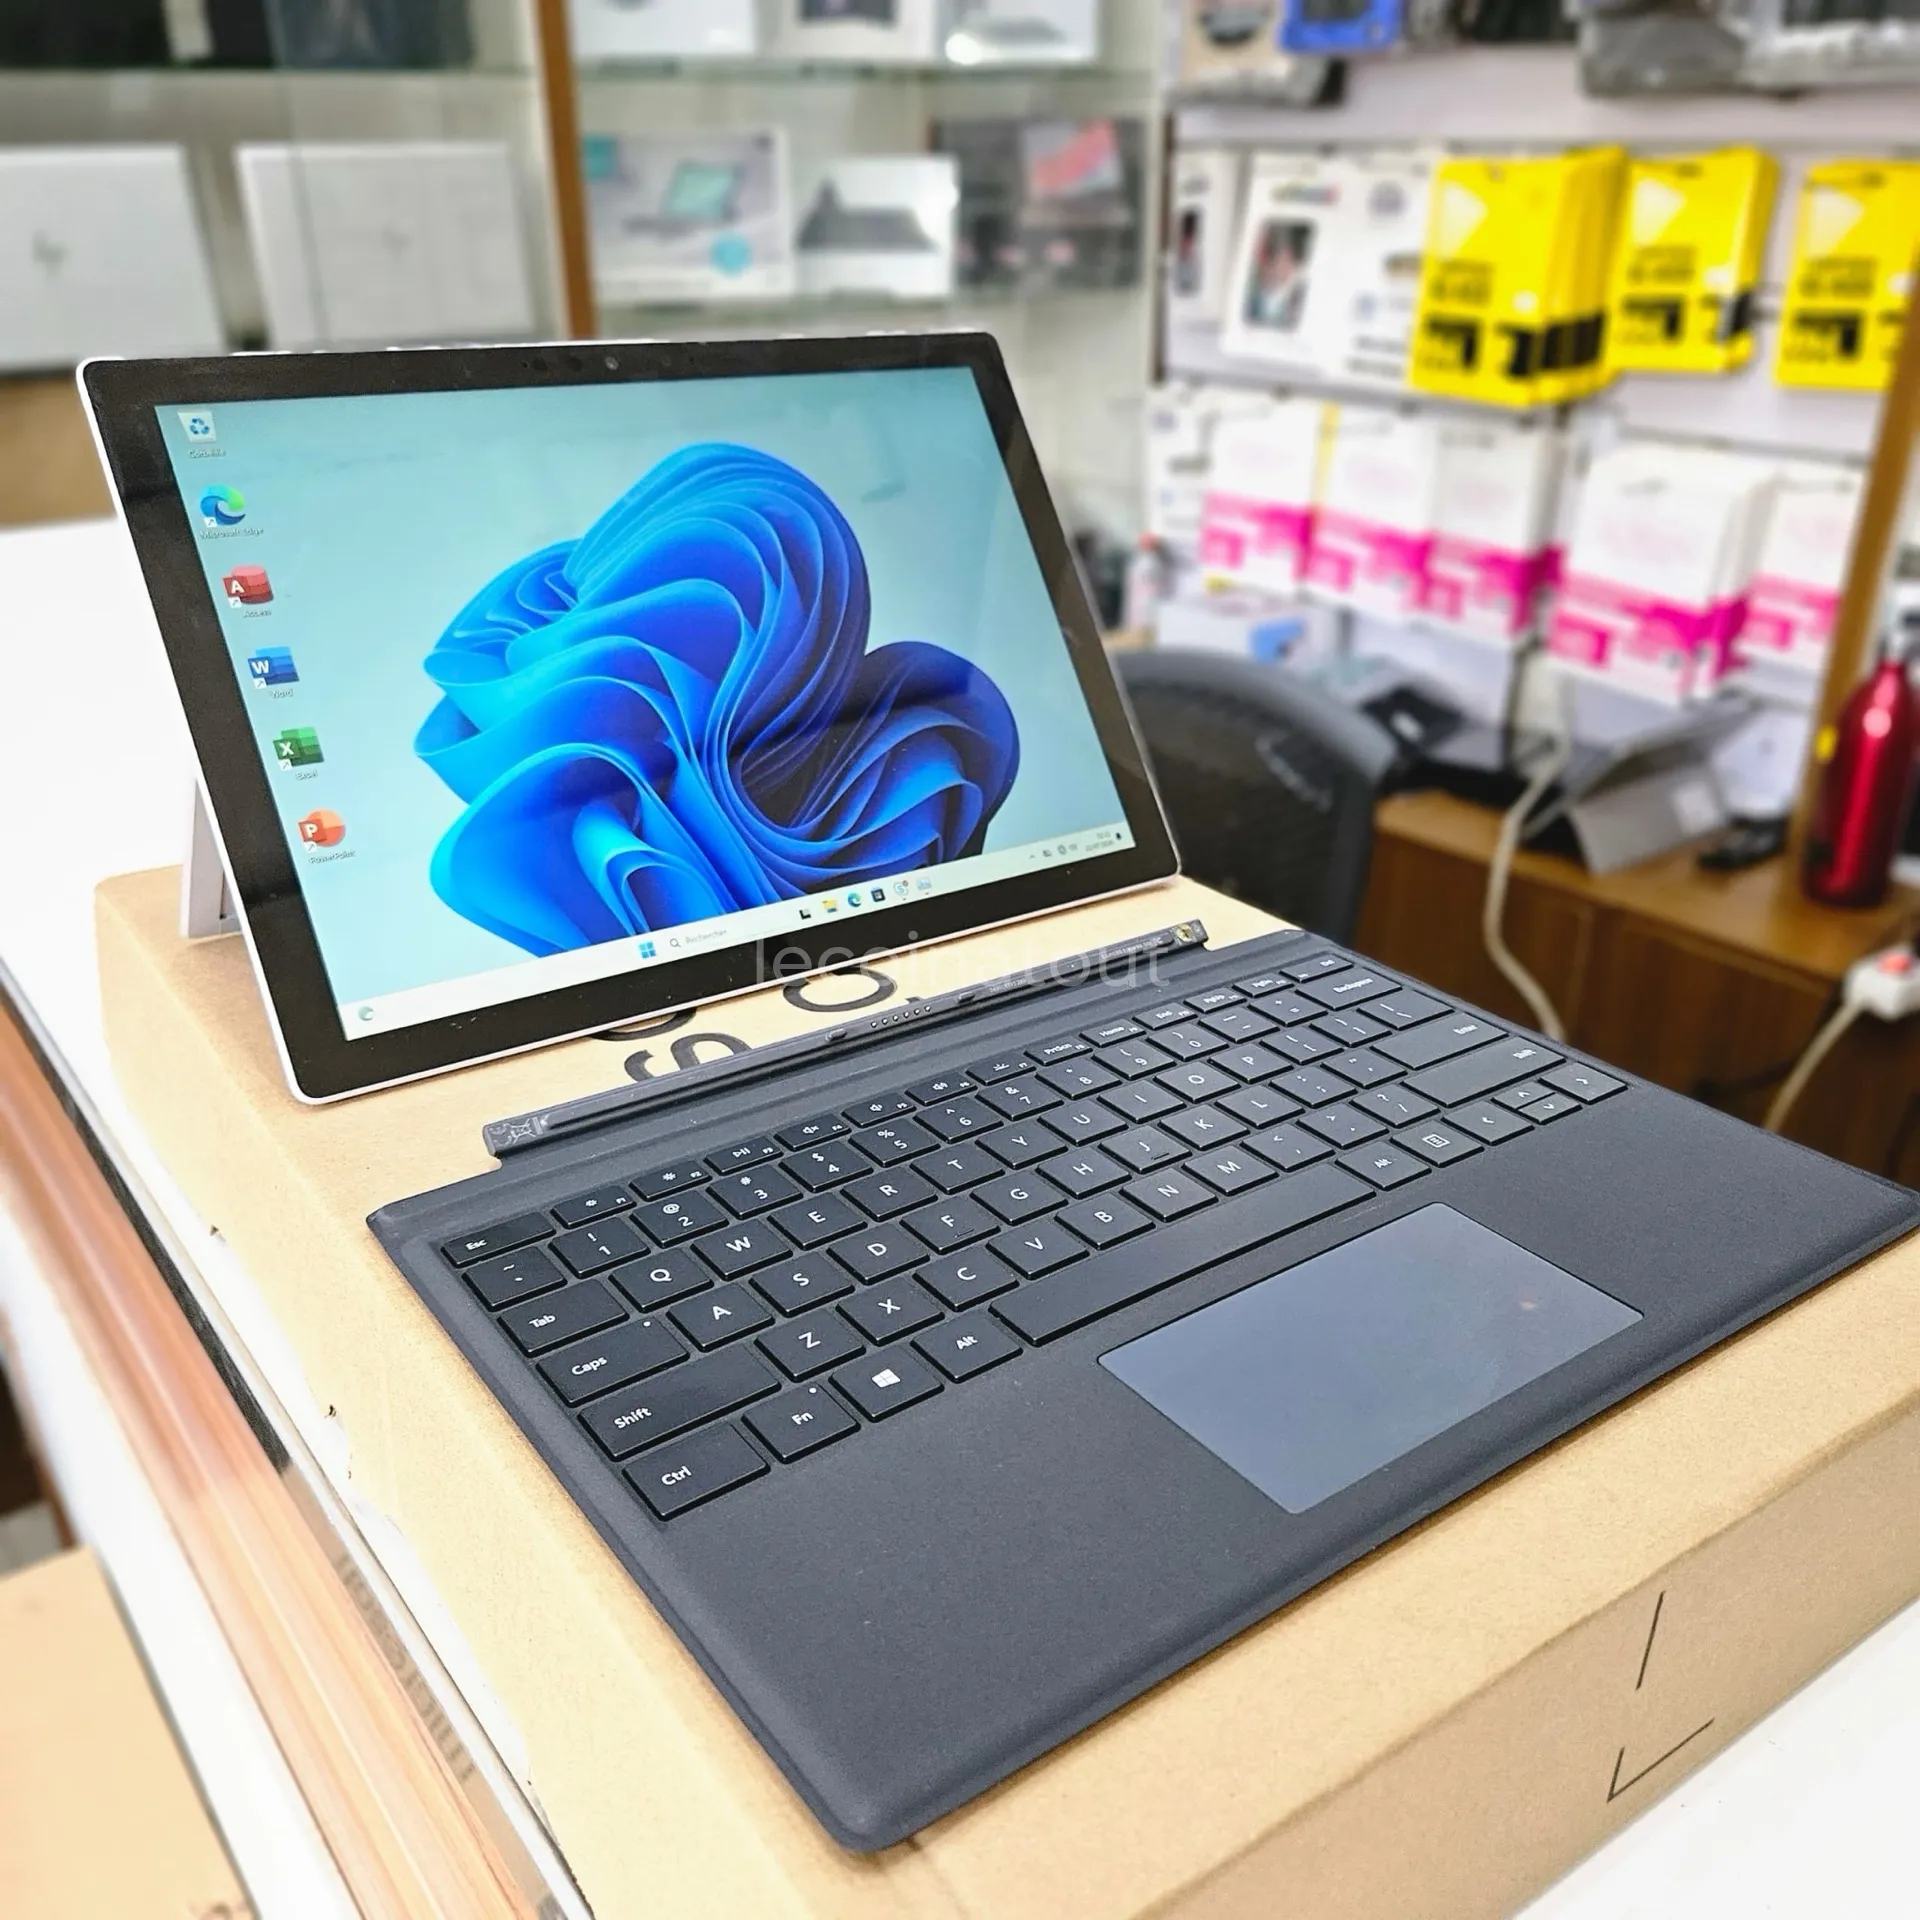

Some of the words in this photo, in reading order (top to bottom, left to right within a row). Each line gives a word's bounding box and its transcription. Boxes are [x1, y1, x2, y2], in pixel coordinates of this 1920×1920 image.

[231, 579, 245, 594] A
[251, 660, 269, 674] W
[279, 741, 294, 757] X
[303, 822, 318, 838] P
[1100, 1027, 1124, 1036] Home
[1242, 1057, 1253, 1065] P
[1189, 1075, 1204, 1083] O
[1020, 1096, 1030, 1104] 7
[960, 1117, 971, 1125] 6
[1073, 1114, 1090, 1123] U
[1195, 1119, 1213, 1129] K
[878, 1130, 894, 1138] %
[894, 1140, 907, 1148] 5
[1012, 1136, 1027, 1145] Y
[1140, 1142, 1150, 1151] J
[812, 1153, 824, 1161] $
[829, 1164, 839, 1172] 4
[948, 1160, 962, 1169] T
[1073, 1163, 1093, 1175] H
[1217, 1161, 1240, 1173] M
[741, 1177, 751, 1185] #
[755, 1190, 767, 1199] 3
[880, 1185, 898, 1195] R
[1011, 1189, 1028, 1199] G
[1158, 1185, 1179, 1197] N
[663, 1204, 679, 1213] @
[679, 1217, 693, 1226] 2
[808, 1211, 825, 1222] E
[941, 1215, 953, 1227] F
[1095, 1212, 1112, 1222] B
[588, 1233, 596, 1241] !
[466, 1240, 486, 1249] Esc
[726, 1237, 750, 1251] W
[1025, 1238, 1043, 1249] V
[599, 1246, 610, 1254] 1
[868, 1244, 886, 1256] D
[651, 1269, 671, 1281] Q
[957, 1267, 976, 1280] C
[793, 1273, 809, 1286] S
[878, 1299, 900, 1314] X
[713, 1306, 731, 1320] A
[529, 1316, 555, 1327] Tab
[799, 1332, 820, 1348] Z
[957, 1337, 977, 1349] Alt
[572, 1358, 607, 1374] Caps
[615, 1408, 651, 1428] Shift
[792, 1413, 813, 1424] Fn
[662, 1466, 691, 1484] Ctrl
